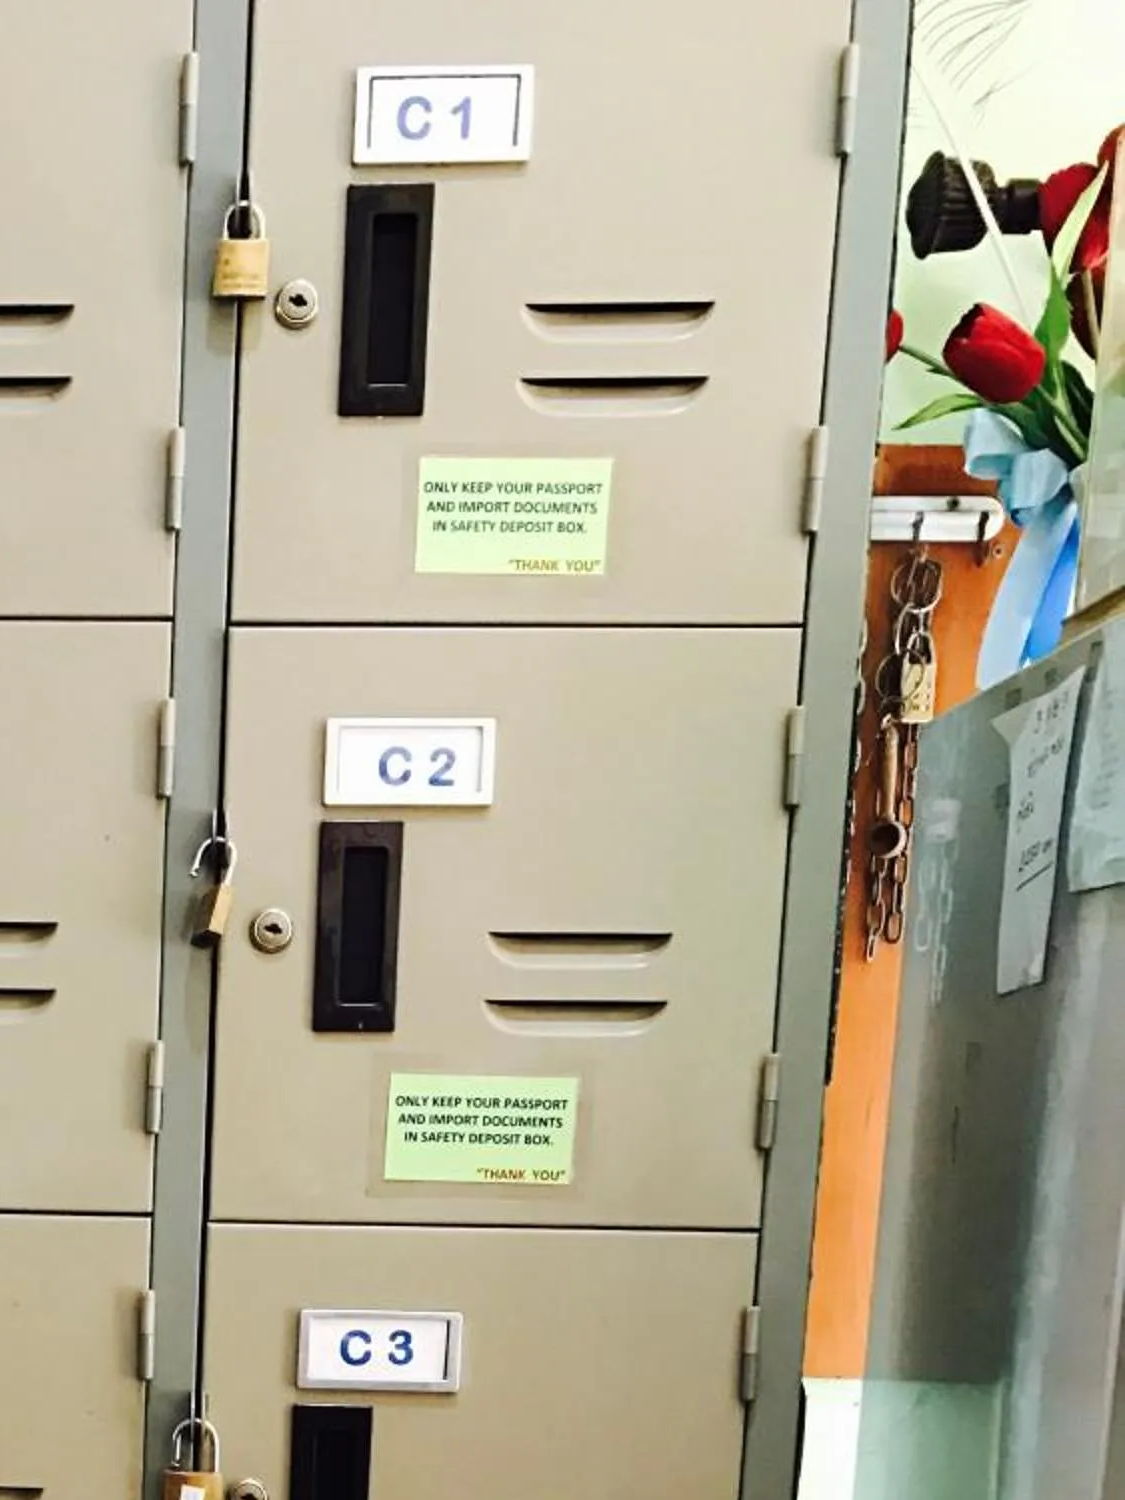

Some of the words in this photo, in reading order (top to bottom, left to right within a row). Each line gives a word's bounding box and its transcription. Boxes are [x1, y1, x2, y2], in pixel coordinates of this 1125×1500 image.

[423, 482, 458, 493] ONLY
[462, 482, 493, 494] KEEP
[497, 482, 533, 494] YOUR
[537, 483, 603, 494] PASSPORT
[427, 501, 455, 512] AND
[459, 501, 511, 513] IMPORT
[514, 501, 597, 514] DOCUMENTS
[433, 520, 447, 532] IN
[451, 520, 496, 532] SAFETY
[499, 520, 554, 533] DEPOSIT
[395, 1095, 429, 1107] ONLY
[432, 1096, 462, 1108] KEEP
[465, 1097, 501, 1109] YOUR
[503, 1097, 568, 1111] PASSPORT
[398, 1113, 425, 1125] AND
[429, 1114, 479, 1126] IMPORT
[482, 1115, 563, 1128] DOCUMENTS
[405, 1131, 417, 1142] IN
[421, 1132, 465, 1143] SAFETY
[469, 1133, 521, 1145] DEPOSIT
